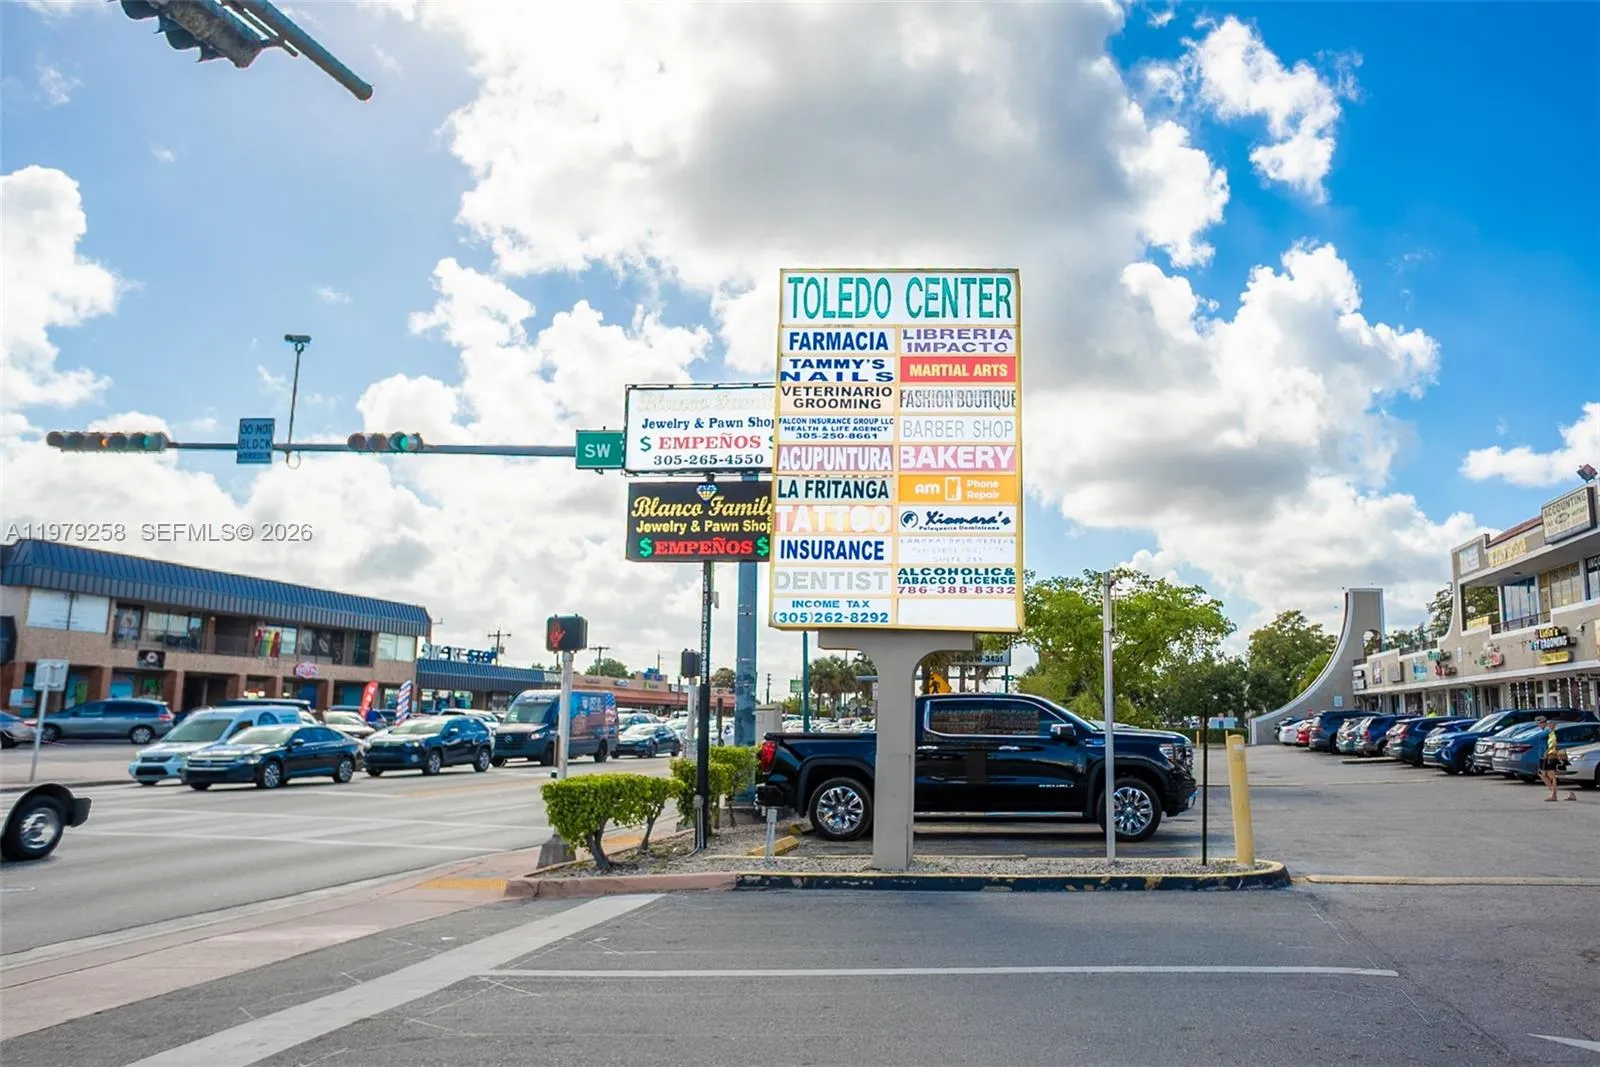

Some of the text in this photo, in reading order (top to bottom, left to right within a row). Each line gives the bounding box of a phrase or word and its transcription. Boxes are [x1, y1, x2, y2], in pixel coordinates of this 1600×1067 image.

[788, 277, 1012, 319] TOLEDO CENTER
[789, 331, 889, 351] FARMACIA
[902, 328, 1013, 340] LIBRERIA
[907, 342, 1008, 353] IMPACTO
[789, 359, 885, 369] TAMMY'S
[909, 364, 1008, 377] MARTIAL ARTS
[780, 371, 894, 382] NAILS
[781, 386, 893, 397] VETERINARIO
[793, 398, 881, 409] GROOMING
[900, 389, 1016, 410] FASHION BOUTIQUE
[641, 418, 690, 431] Jewelry
[694, 417, 704, 428] &
[708, 417, 743, 428] Pawn
[778, 417, 807, 425] FALCON
[903, 420, 1014, 438] BARBER SHOP
[640, 436, 652, 452] $
[658, 432, 761, 449] EMPEÑOS
[584, 443, 611, 459] SW
[778, 446, 892, 470] ACUPUNTURA
[900, 446, 1015, 469] BAKERY
[653, 454, 764, 466] 305-265-4550
[778, 480, 889, 498] LA FRITANGA
[914, 483, 940, 494] am
[966, 480, 1000, 488] Phone
[966, 491, 1000, 500] Repair
[631, 496, 704, 518] Blanco
[1544, 492, 1586, 518] ACCOUNTING
[776, 505, 892, 532] TATTOO
[925, 511, 1011, 525] Xiomara's
[636, 520, 687, 535] Jewelry
[690, 520, 700, 532] &
[704, 520, 739, 532] Pawn
[639, 536, 769, 557] $ EMPEÑOS $
[780, 540, 885, 560] INSURANCE
[775, 571, 889, 590] DENTIST
[897, 577, 1016, 585] TABACCO LICENSE
[897, 586, 1016, 594] 786-388-8332
[792, 600, 870, 608] INCOME TAX
[773, 612, 889, 623] (305)262-8292
